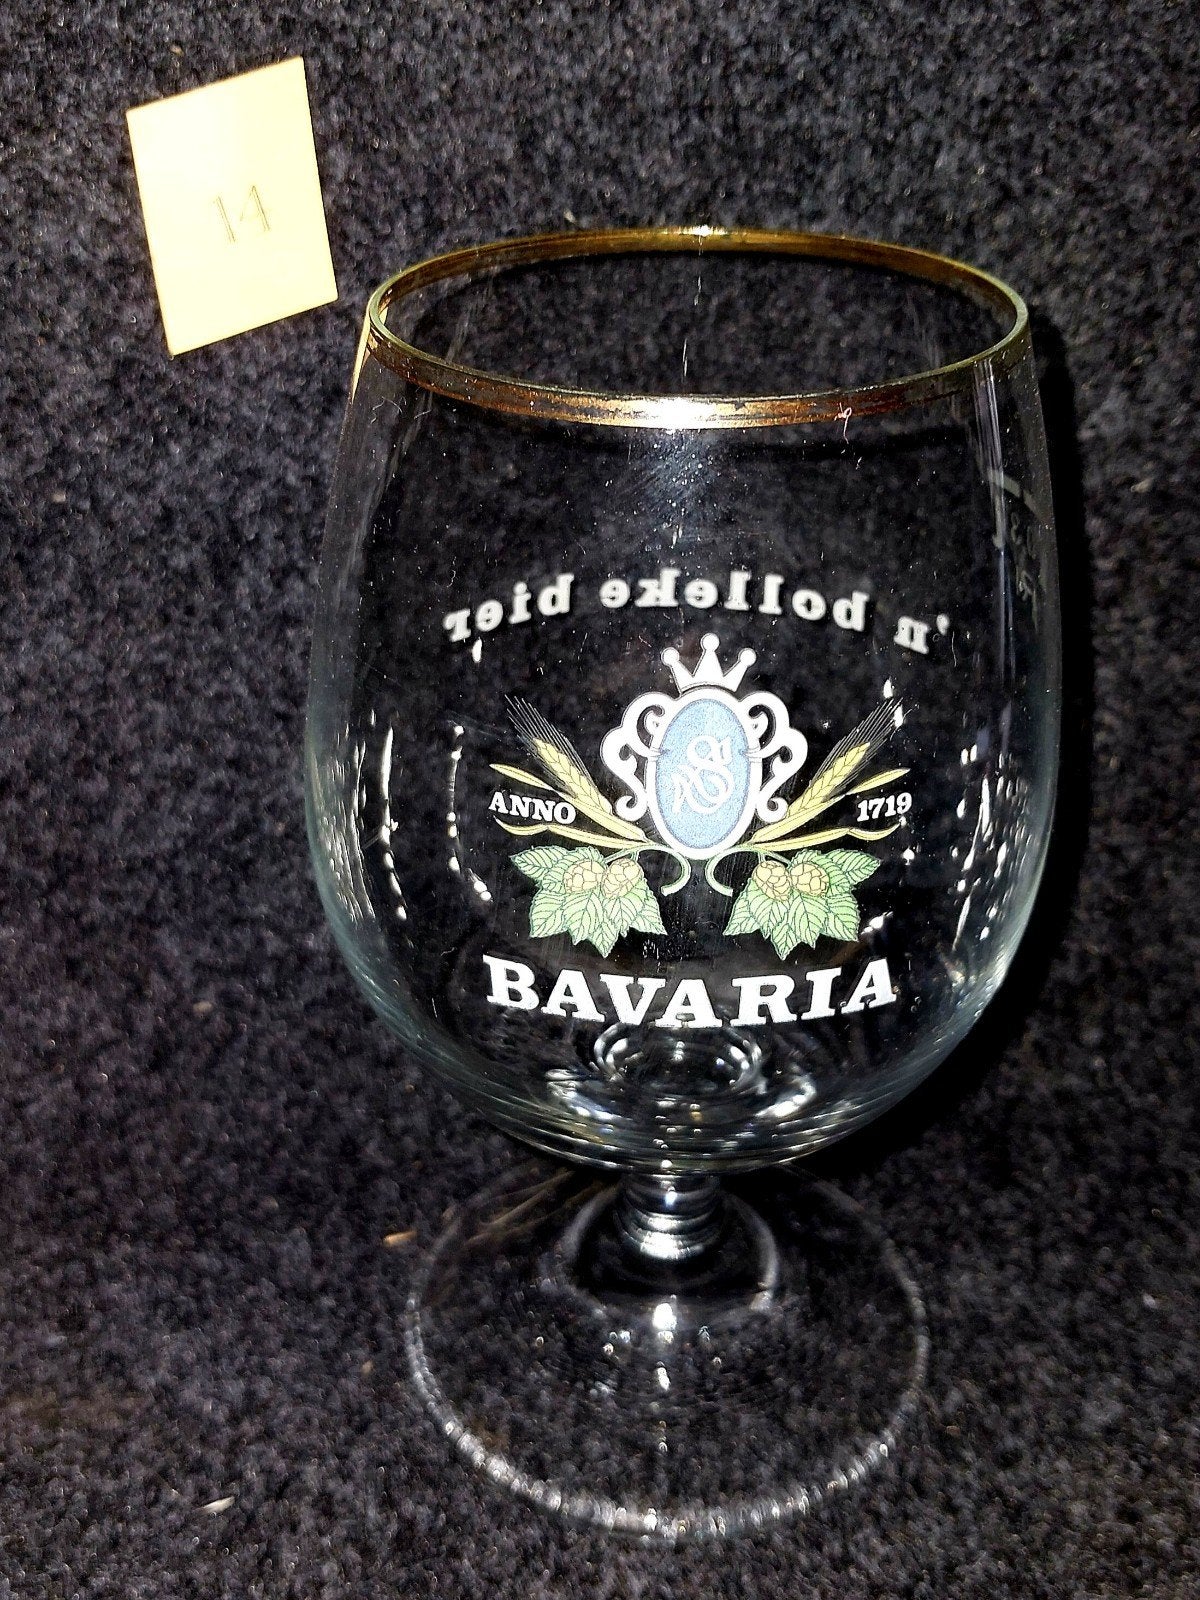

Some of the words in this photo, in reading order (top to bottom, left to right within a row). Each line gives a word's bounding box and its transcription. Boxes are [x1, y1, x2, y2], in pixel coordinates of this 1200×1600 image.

[488, 791, 577, 825] ANNO
[856, 792, 913, 823] 1719
[482, 953, 898, 1029] BAVARIA
